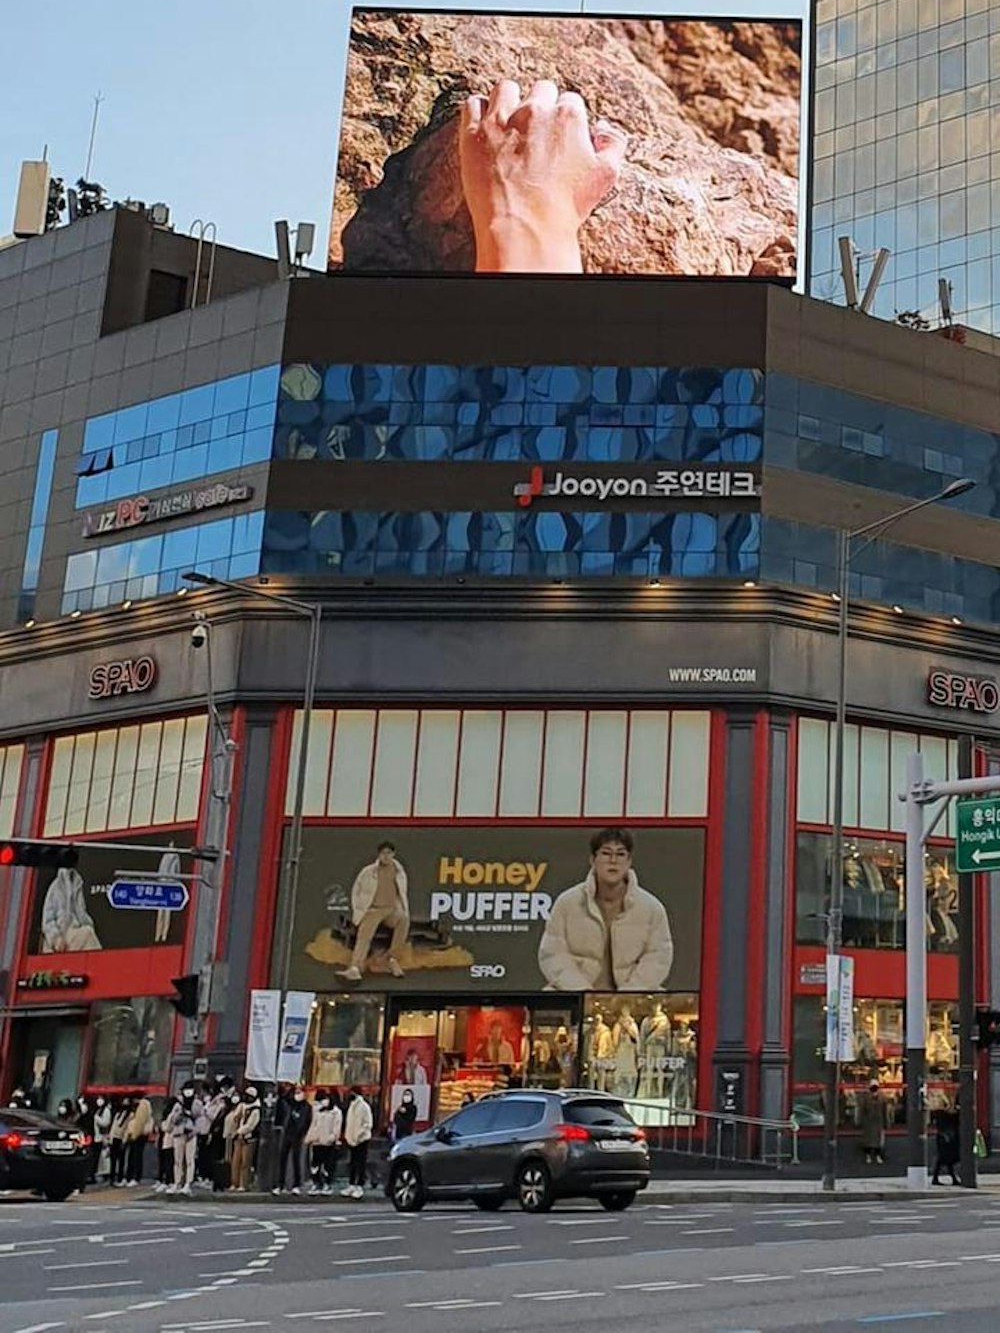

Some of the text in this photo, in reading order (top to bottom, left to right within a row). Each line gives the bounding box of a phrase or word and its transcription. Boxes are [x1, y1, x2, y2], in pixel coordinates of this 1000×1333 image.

[549, 470, 757, 500] Jooyon 주연테크
[88, 656, 155, 699] SPAO
[668, 668, 756, 682] WWW.SPAO.COM
[929, 671, 1000, 713] SPAO
[961, 830, 995, 844] Hongik
[439, 856, 548, 891] Honey
[430, 892, 553, 921] PUFFER
[470, 965, 506, 978] SPAO
